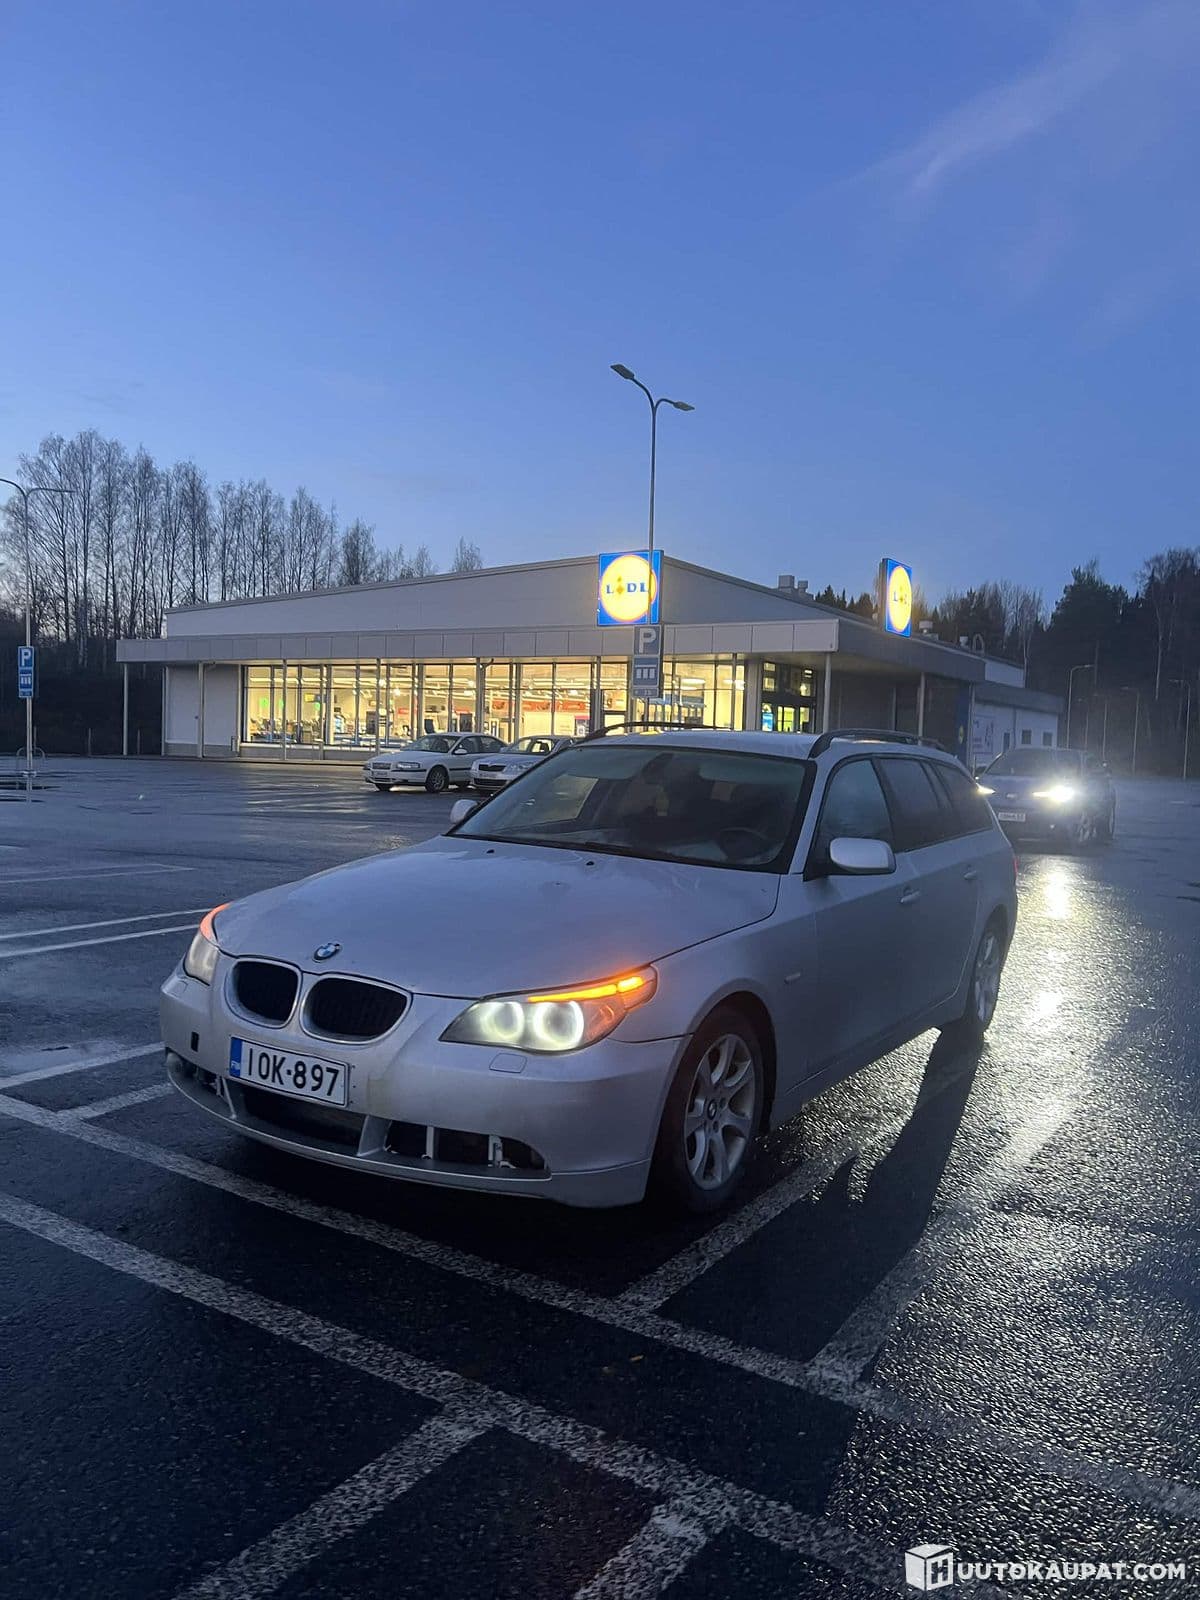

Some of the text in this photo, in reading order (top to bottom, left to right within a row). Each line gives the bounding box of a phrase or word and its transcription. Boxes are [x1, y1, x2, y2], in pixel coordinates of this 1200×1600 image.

[638, 627, 657, 654] P
[21, 649, 31, 666] P
[248, 1047, 340, 1097] IOK-897
